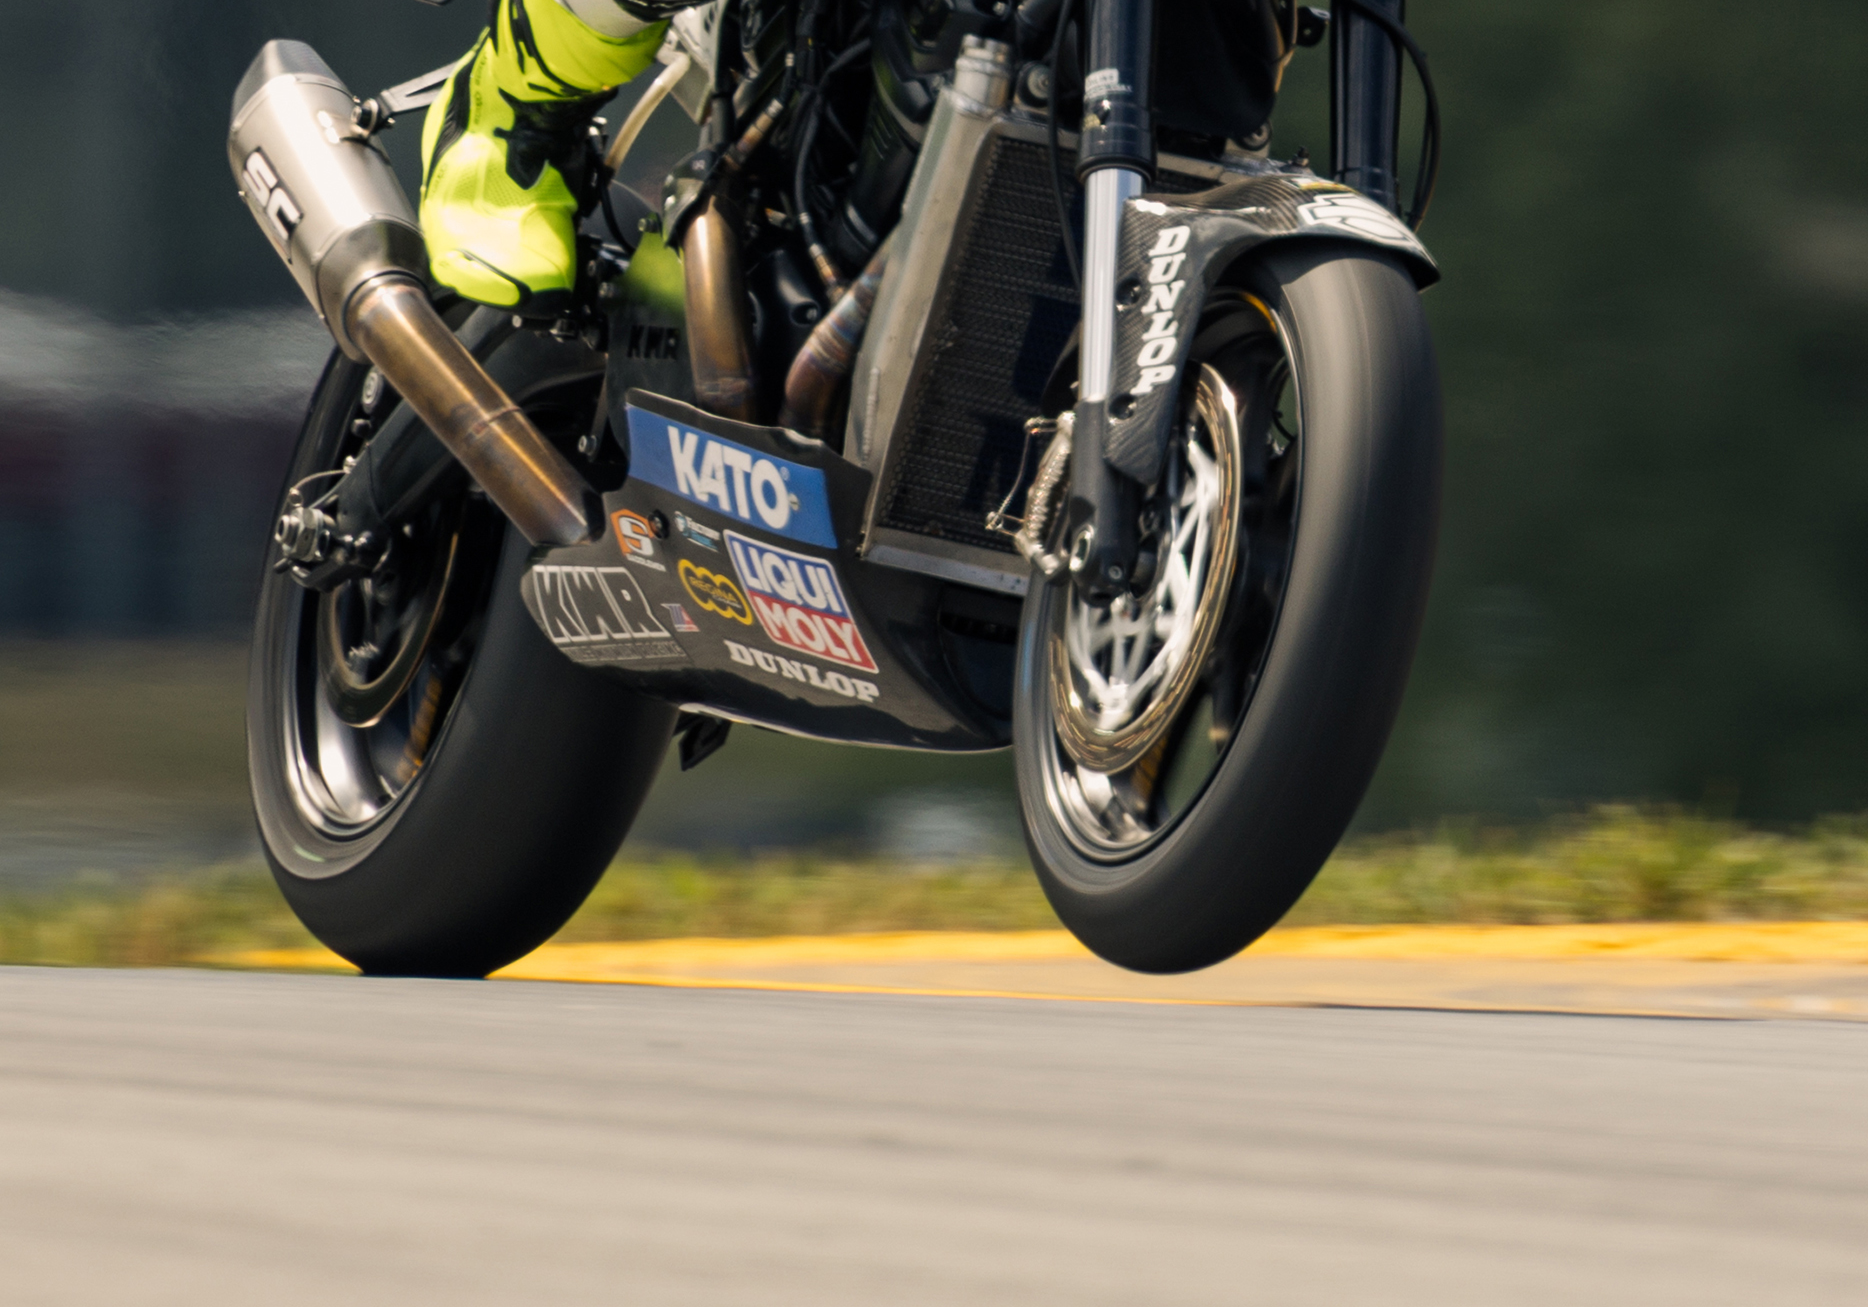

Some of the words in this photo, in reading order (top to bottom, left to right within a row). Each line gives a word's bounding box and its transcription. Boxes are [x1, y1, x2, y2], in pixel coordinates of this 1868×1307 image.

[243, 151, 300, 242] SC
[1130, 225, 1190, 396] DUNLOP
[667, 425, 792, 530] KATO
[532, 564, 673, 644] KWR
[733, 540, 845, 614] LIQUI
[751, 594, 865, 664] MOLY
[723, 639, 880, 704] DUNLOP
